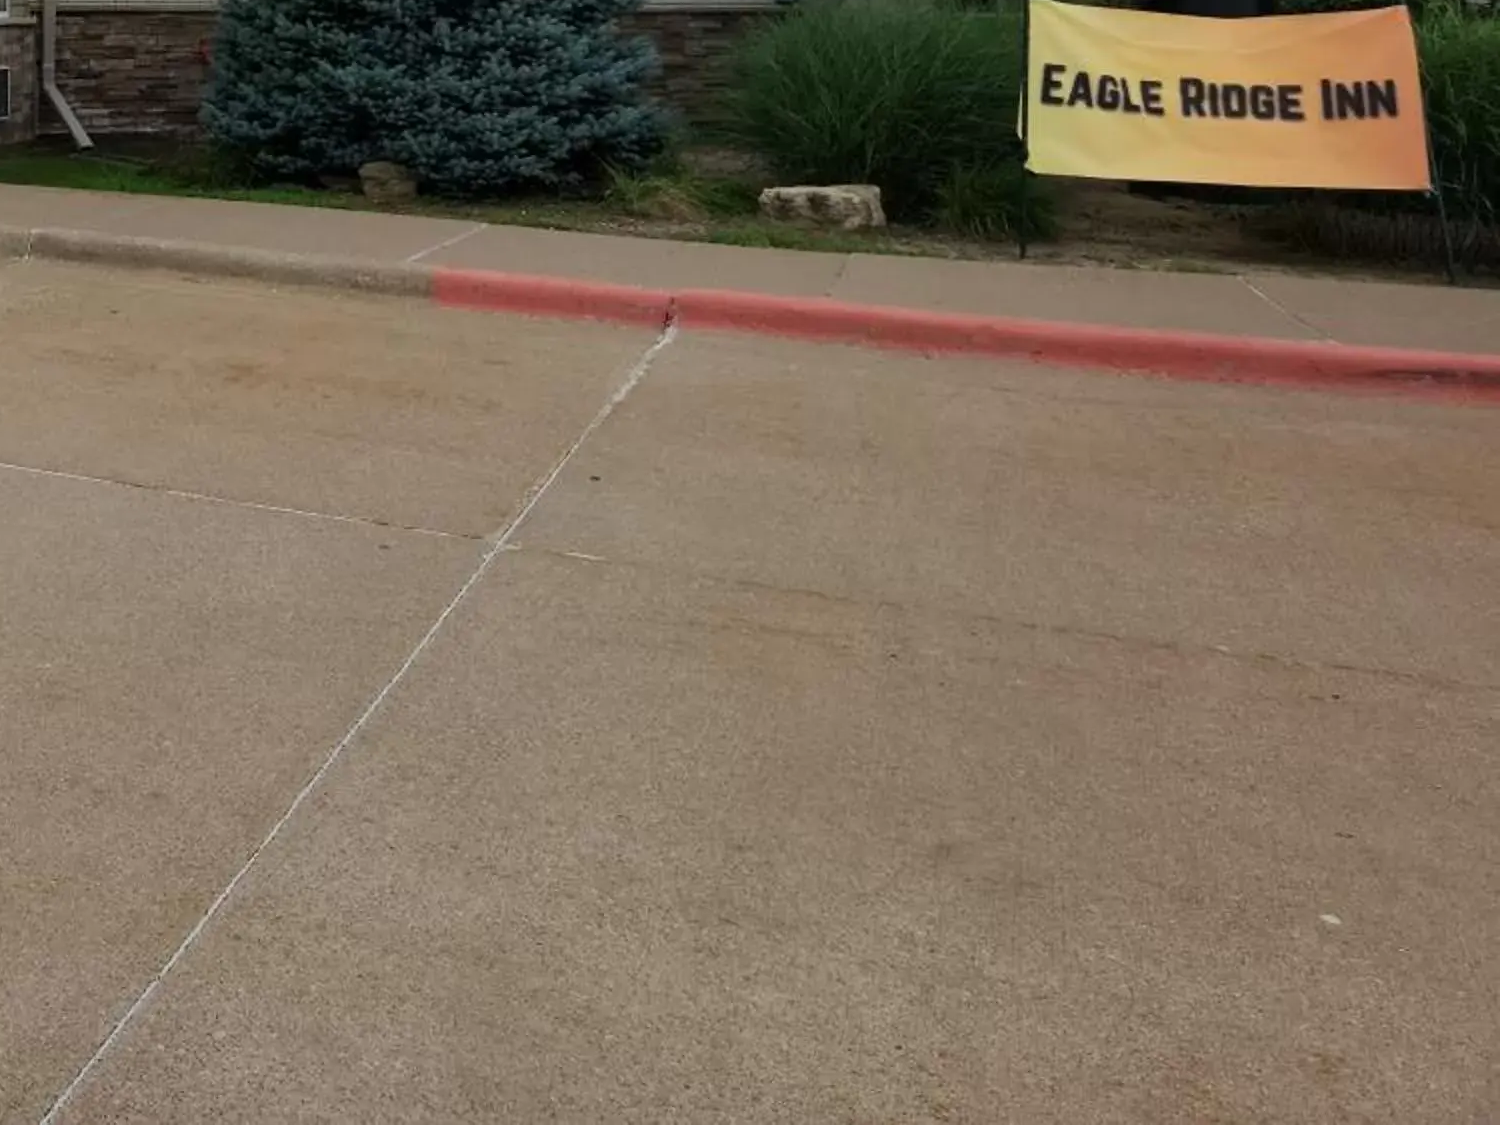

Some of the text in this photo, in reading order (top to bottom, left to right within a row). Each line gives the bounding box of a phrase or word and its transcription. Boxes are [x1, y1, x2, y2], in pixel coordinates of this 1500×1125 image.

[1040, 63, 1399, 122] EAGLE RIDGE INN
